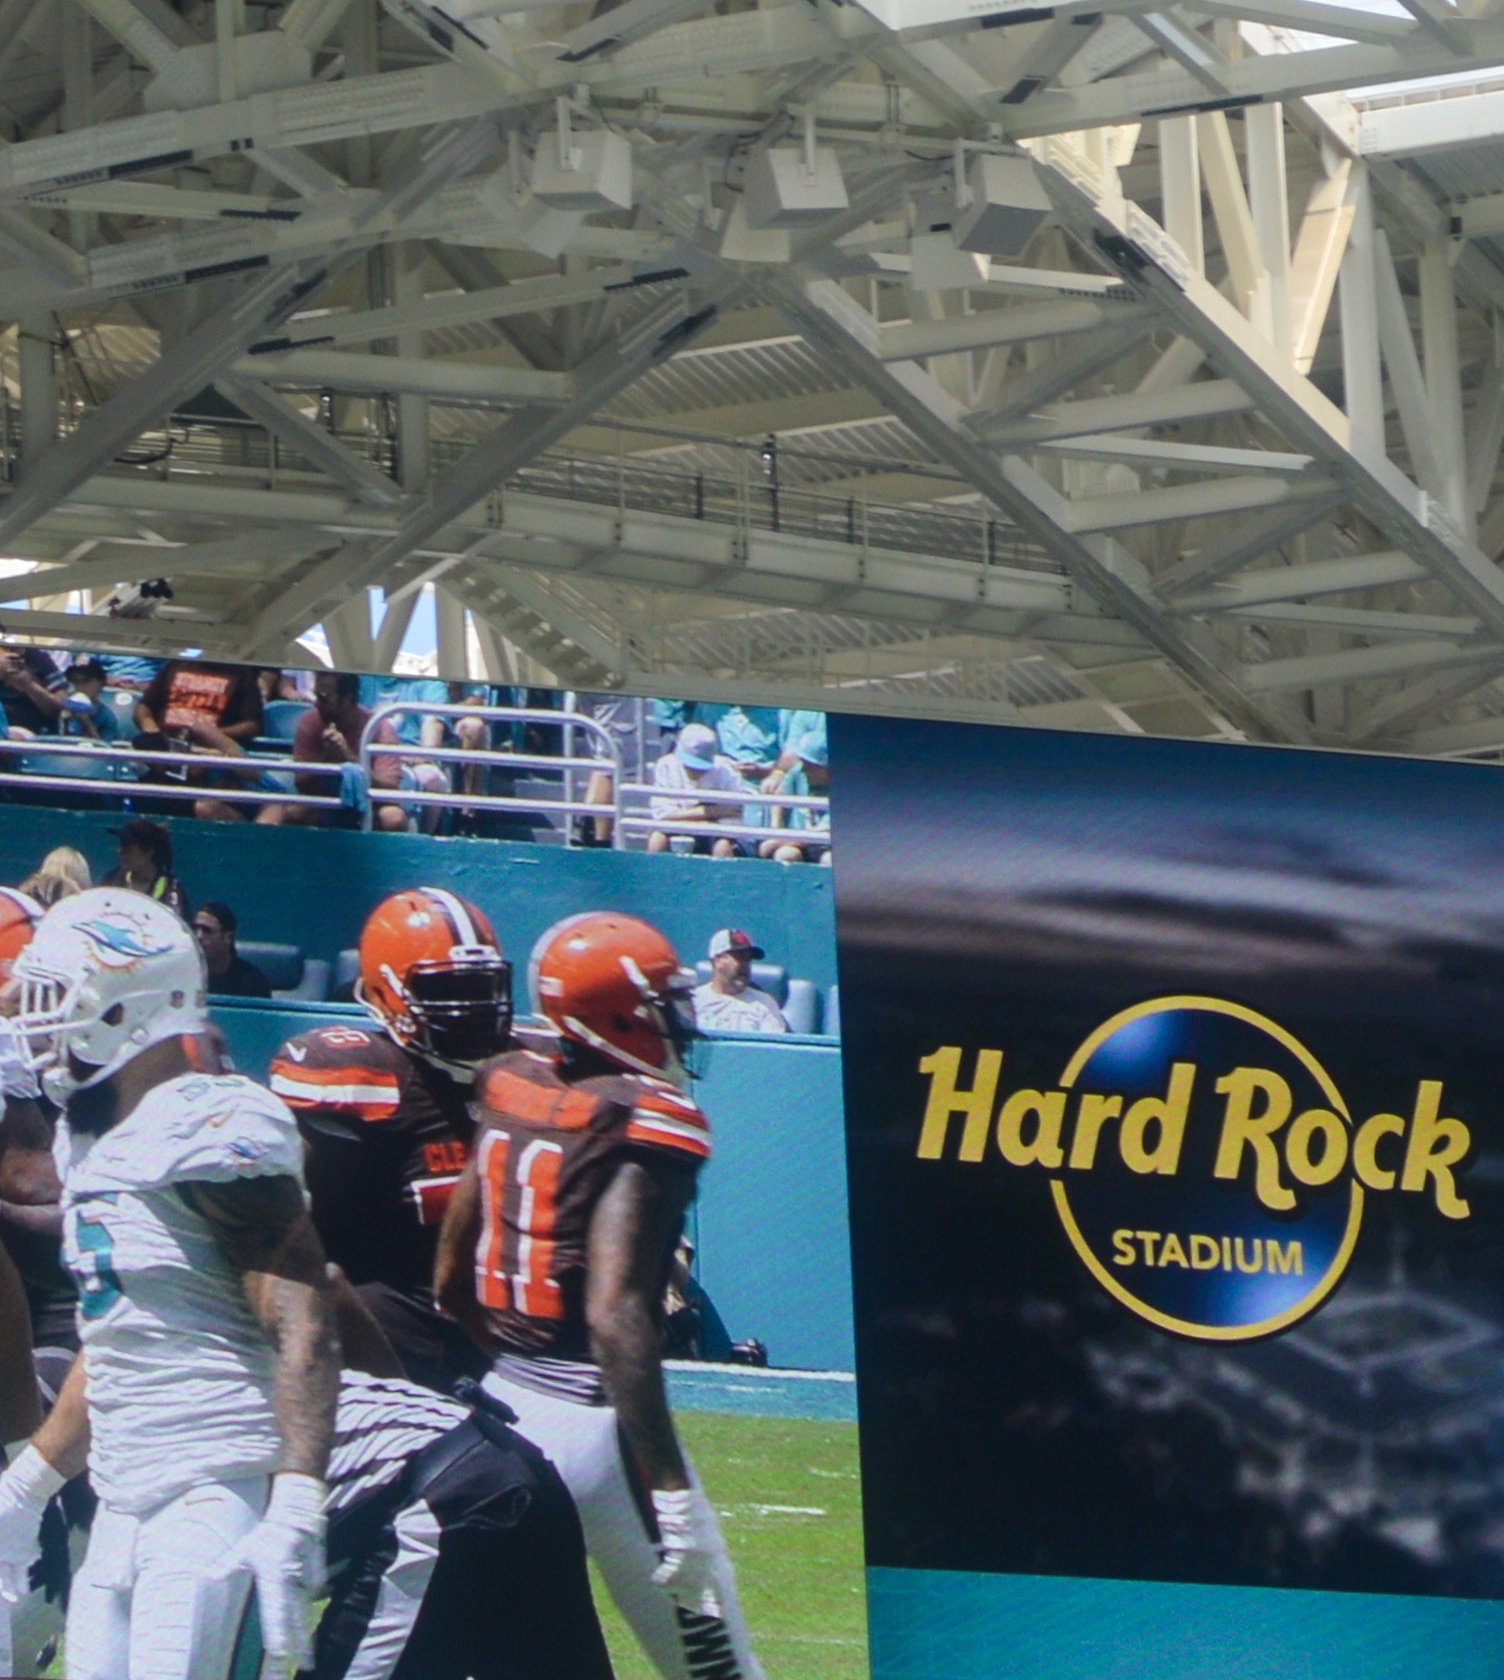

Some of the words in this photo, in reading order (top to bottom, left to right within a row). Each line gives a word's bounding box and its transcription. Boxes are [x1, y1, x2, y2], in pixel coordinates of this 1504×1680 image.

[916, 1045, 1196, 1177] Hard
[1213, 1066, 1472, 1220] Rock
[475, 1129, 565, 1321] 11
[1111, 1229, 1304, 1276] STADIUM
